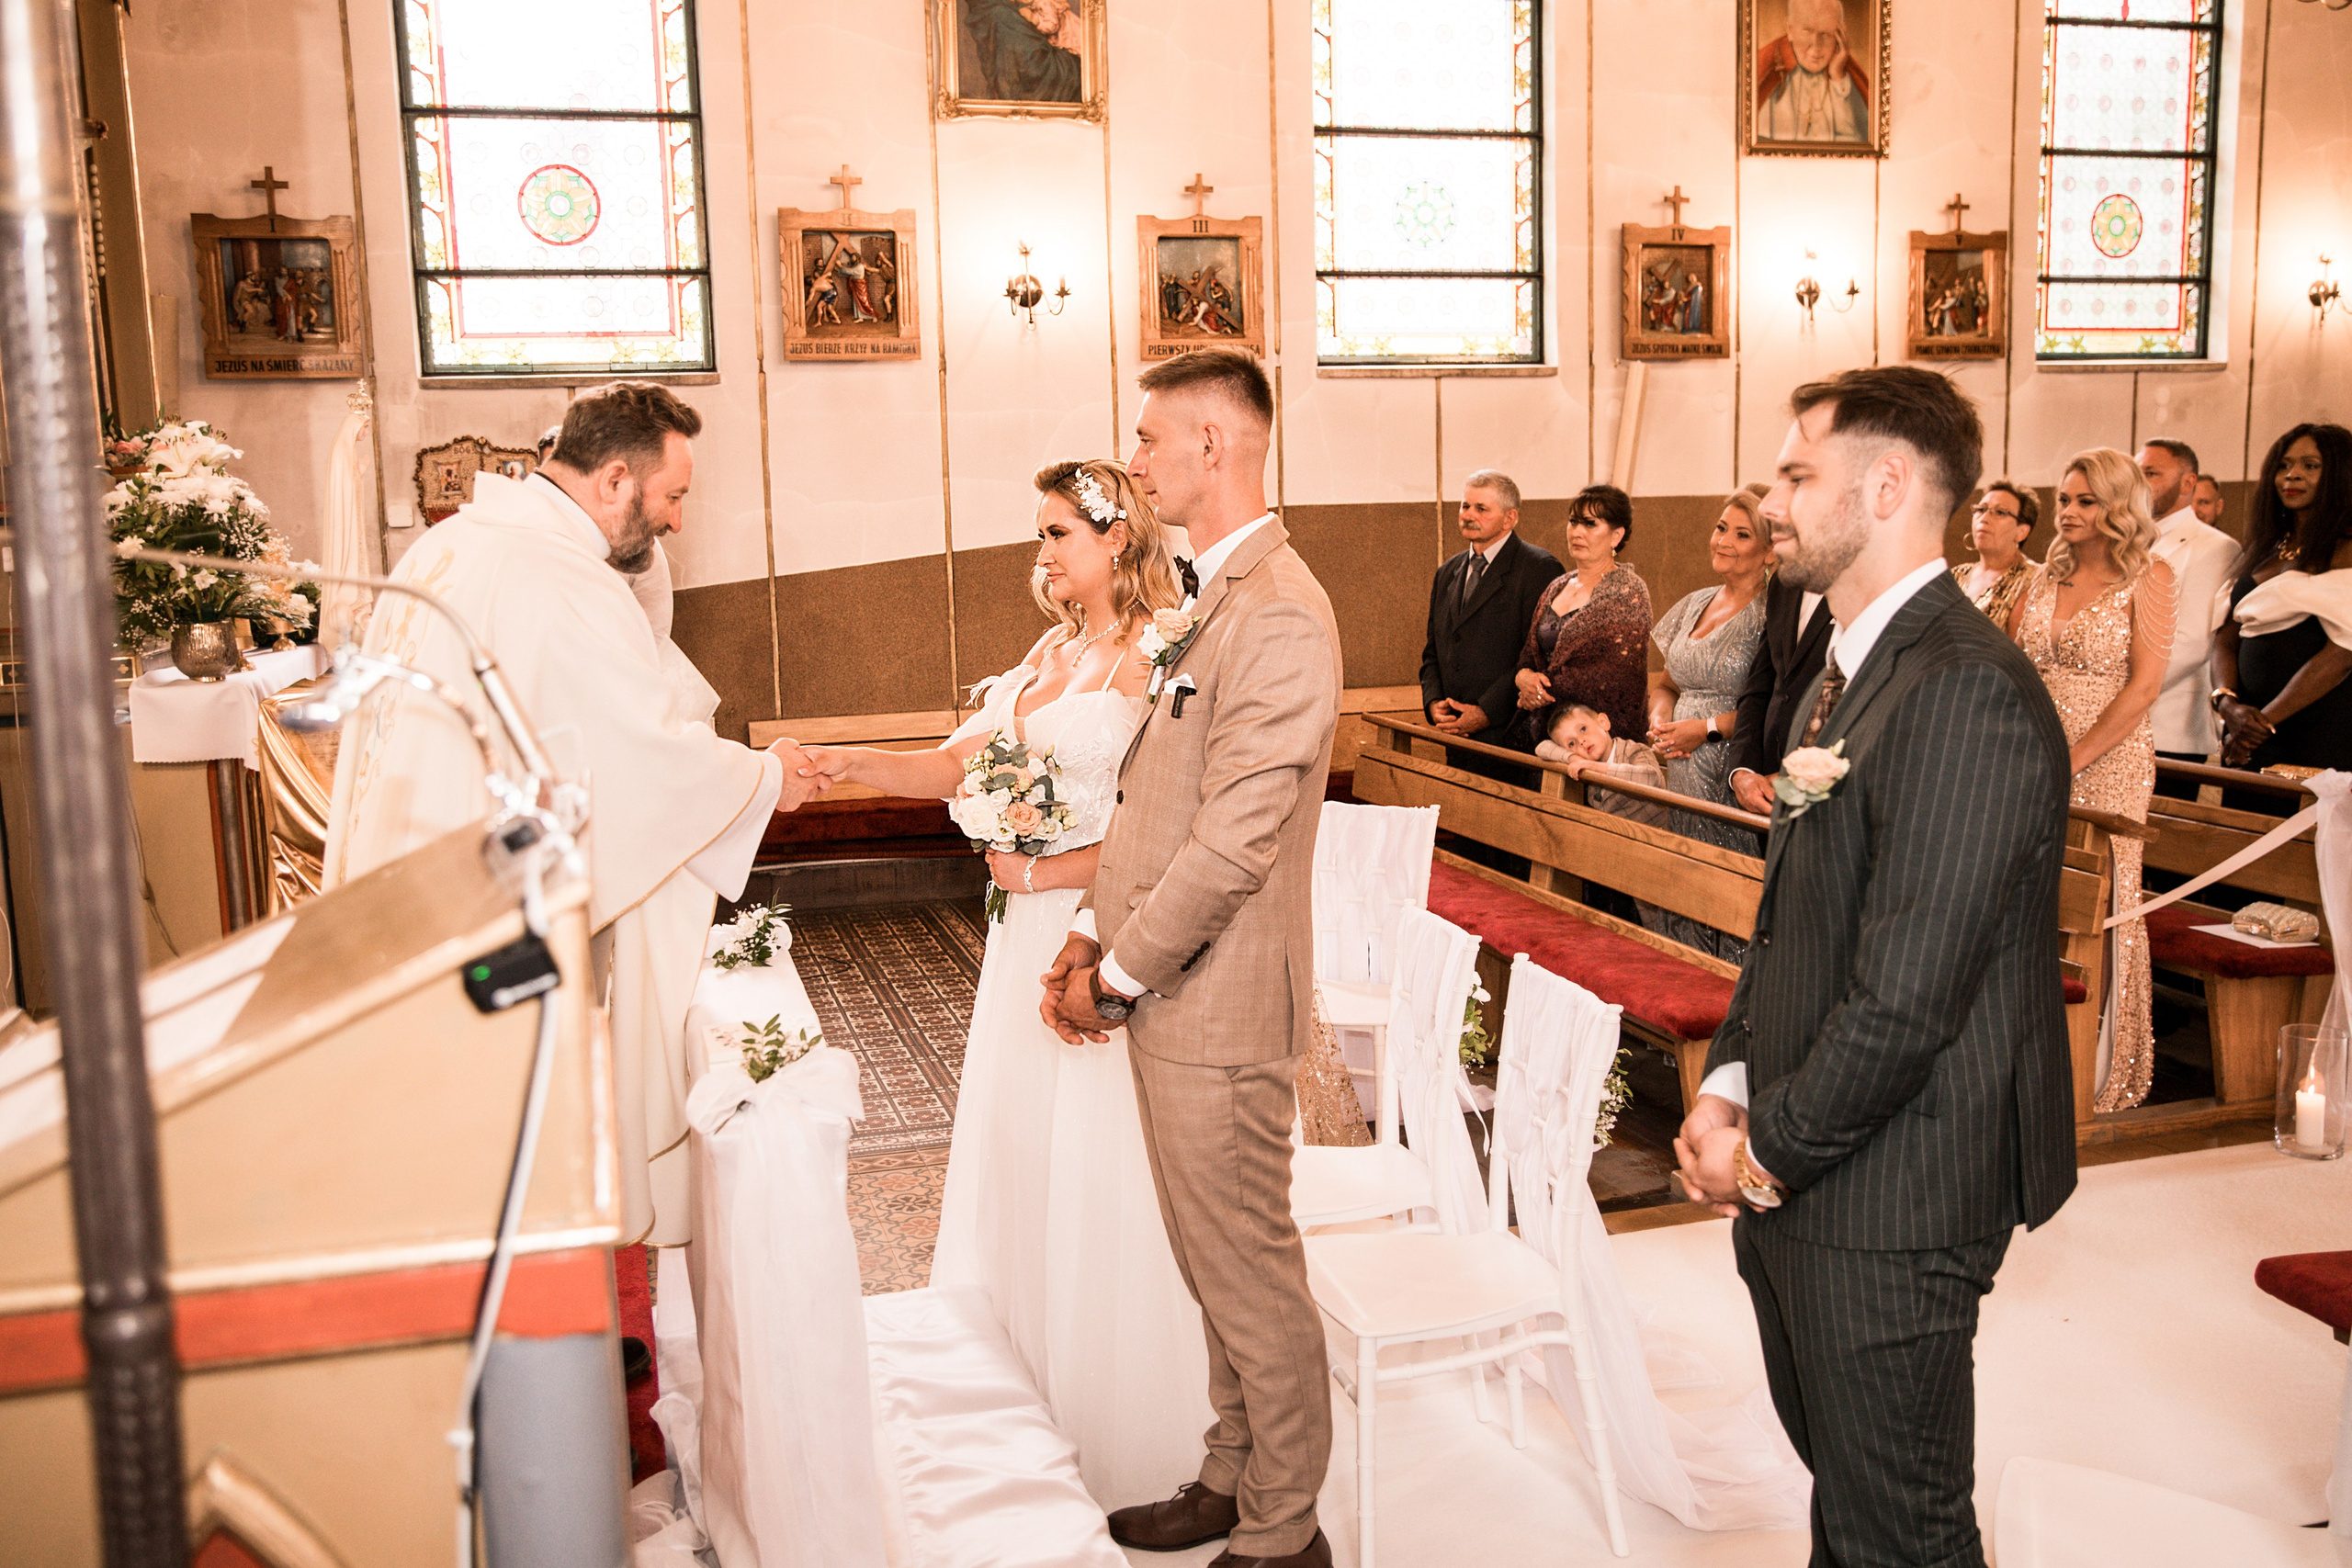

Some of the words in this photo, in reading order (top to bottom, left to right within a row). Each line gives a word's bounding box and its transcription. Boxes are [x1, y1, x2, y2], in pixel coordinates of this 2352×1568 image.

[269, 218, 276, 233] I
[1193, 220, 1209, 233] III
[1671, 228, 1685, 242] IV
[1955, 234, 1963, 246] V
[790, 343, 813, 355] JEZUS
[815, 343, 842, 355] BIERZE
[870, 343, 881, 355] NA
[1148, 344, 1190, 355] PIERWSZY
[215, 360, 248, 373] JEZUS
[250, 359, 266, 373] NA
[308, 359, 355, 373] SKAZANY
[454, 444, 471, 455] BÓG
